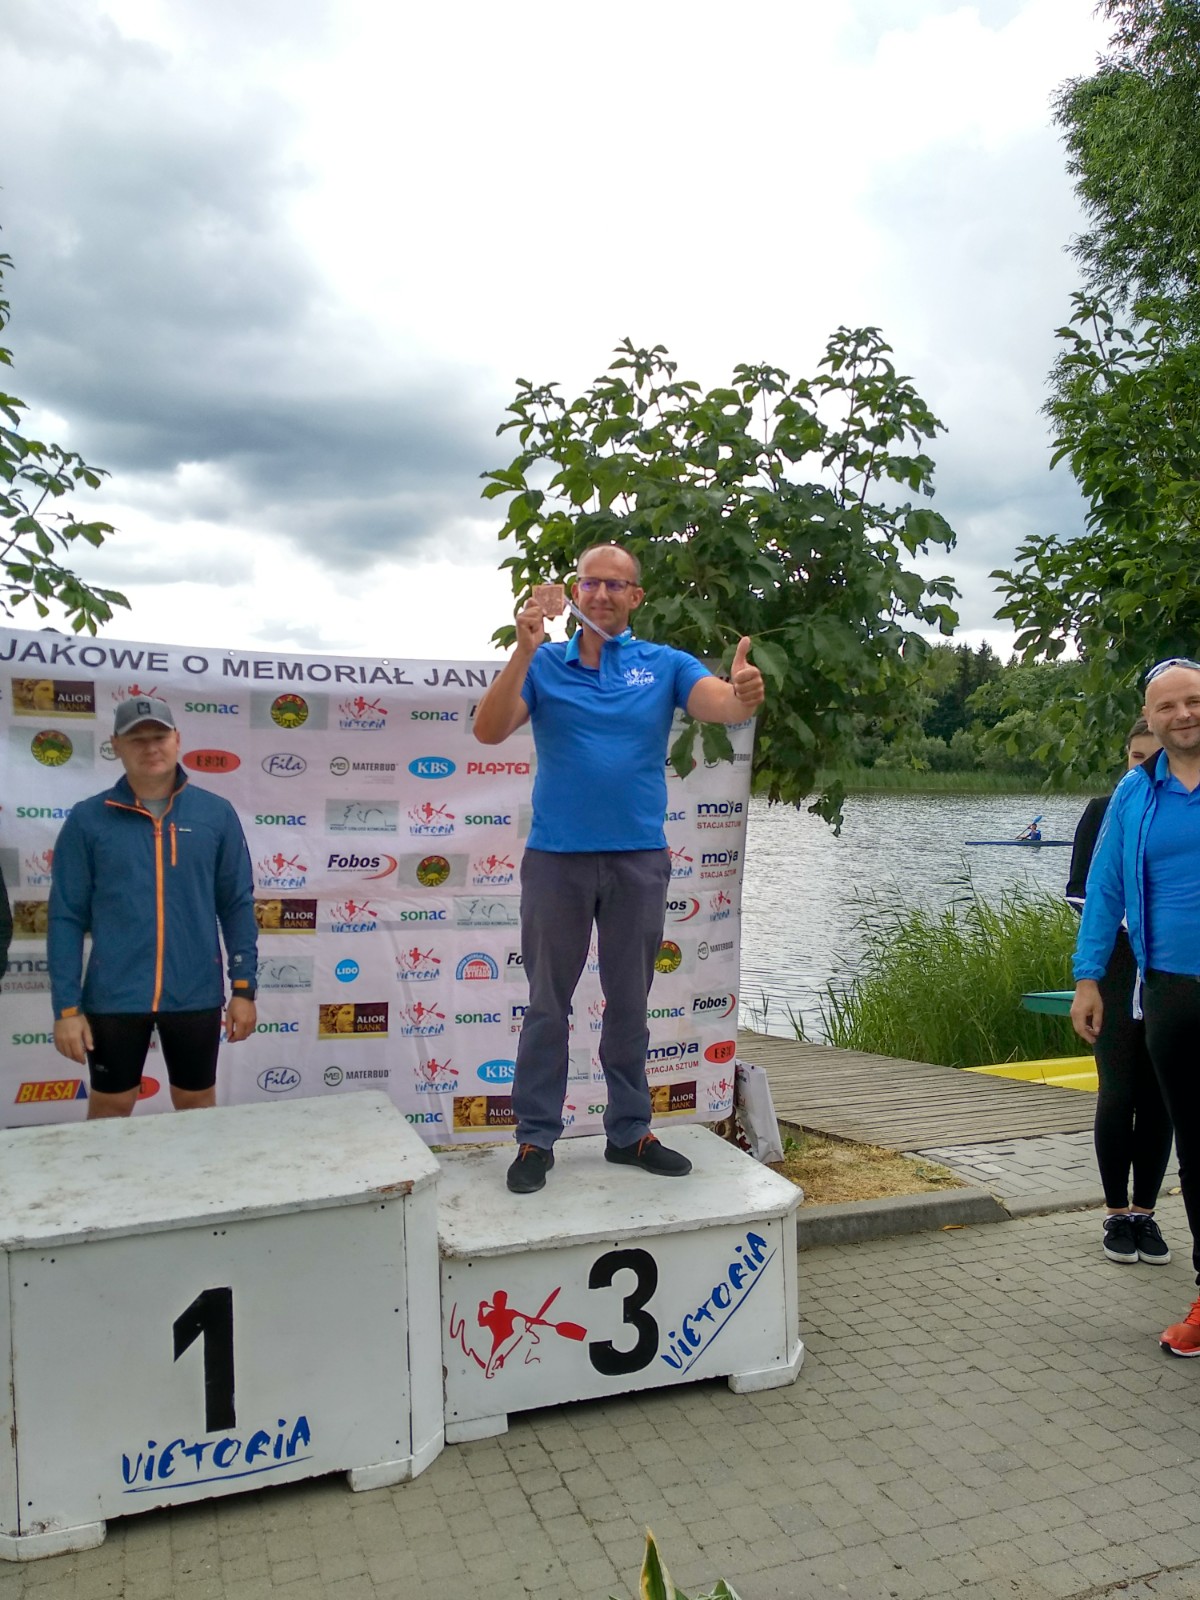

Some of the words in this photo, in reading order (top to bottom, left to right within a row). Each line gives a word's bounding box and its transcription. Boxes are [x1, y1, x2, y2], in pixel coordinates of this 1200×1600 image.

[0, 639, 169, 672] JAKOWE
[183, 655, 209, 675] O
[222, 658, 413, 686] MEMORIAŁ
[57, 693, 92, 703] ALIOR
[58, 703, 87, 712] BANK
[185, 702, 239, 715] sonac
[411, 710, 459, 722] sonac
[269, 755, 303, 773] Fila
[352, 761, 397, 772] MATERBUD
[417, 761, 450, 775] KBS
[255, 813, 307, 826] sonac
[464, 814, 512, 825] sonac
[697, 821, 724, 830] STACJA
[327, 853, 381, 868] Fobos
[700, 871, 723, 880] STACJA
[284, 911, 314, 920] ALIOR
[400, 909, 447, 922] sonac
[284, 920, 310, 928] BANK
[336, 966, 358, 976] LIDO
[693, 995, 728, 1011] Fobos
[357, 1015, 386, 1024] ALIOR
[455, 1011, 502, 1024] sonac
[256, 1021, 299, 1034] onac
[357, 1024, 382, 1032] BANK
[345, 1069, 390, 1081] MATERBUD
[645, 1064, 674, 1076] STACJA
[675, 1061, 699, 1071] SZTUM
[264, 1069, 298, 1090] Fila
[20, 1081, 74, 1102] BLESA
[671, 1093, 694, 1103] ALIOR
[671, 1102, 692, 1110] BANK
[404, 1111, 443, 1125] onac
[588, 1248, 660, 1377] 3
[172, 1286, 237, 1434] 1
